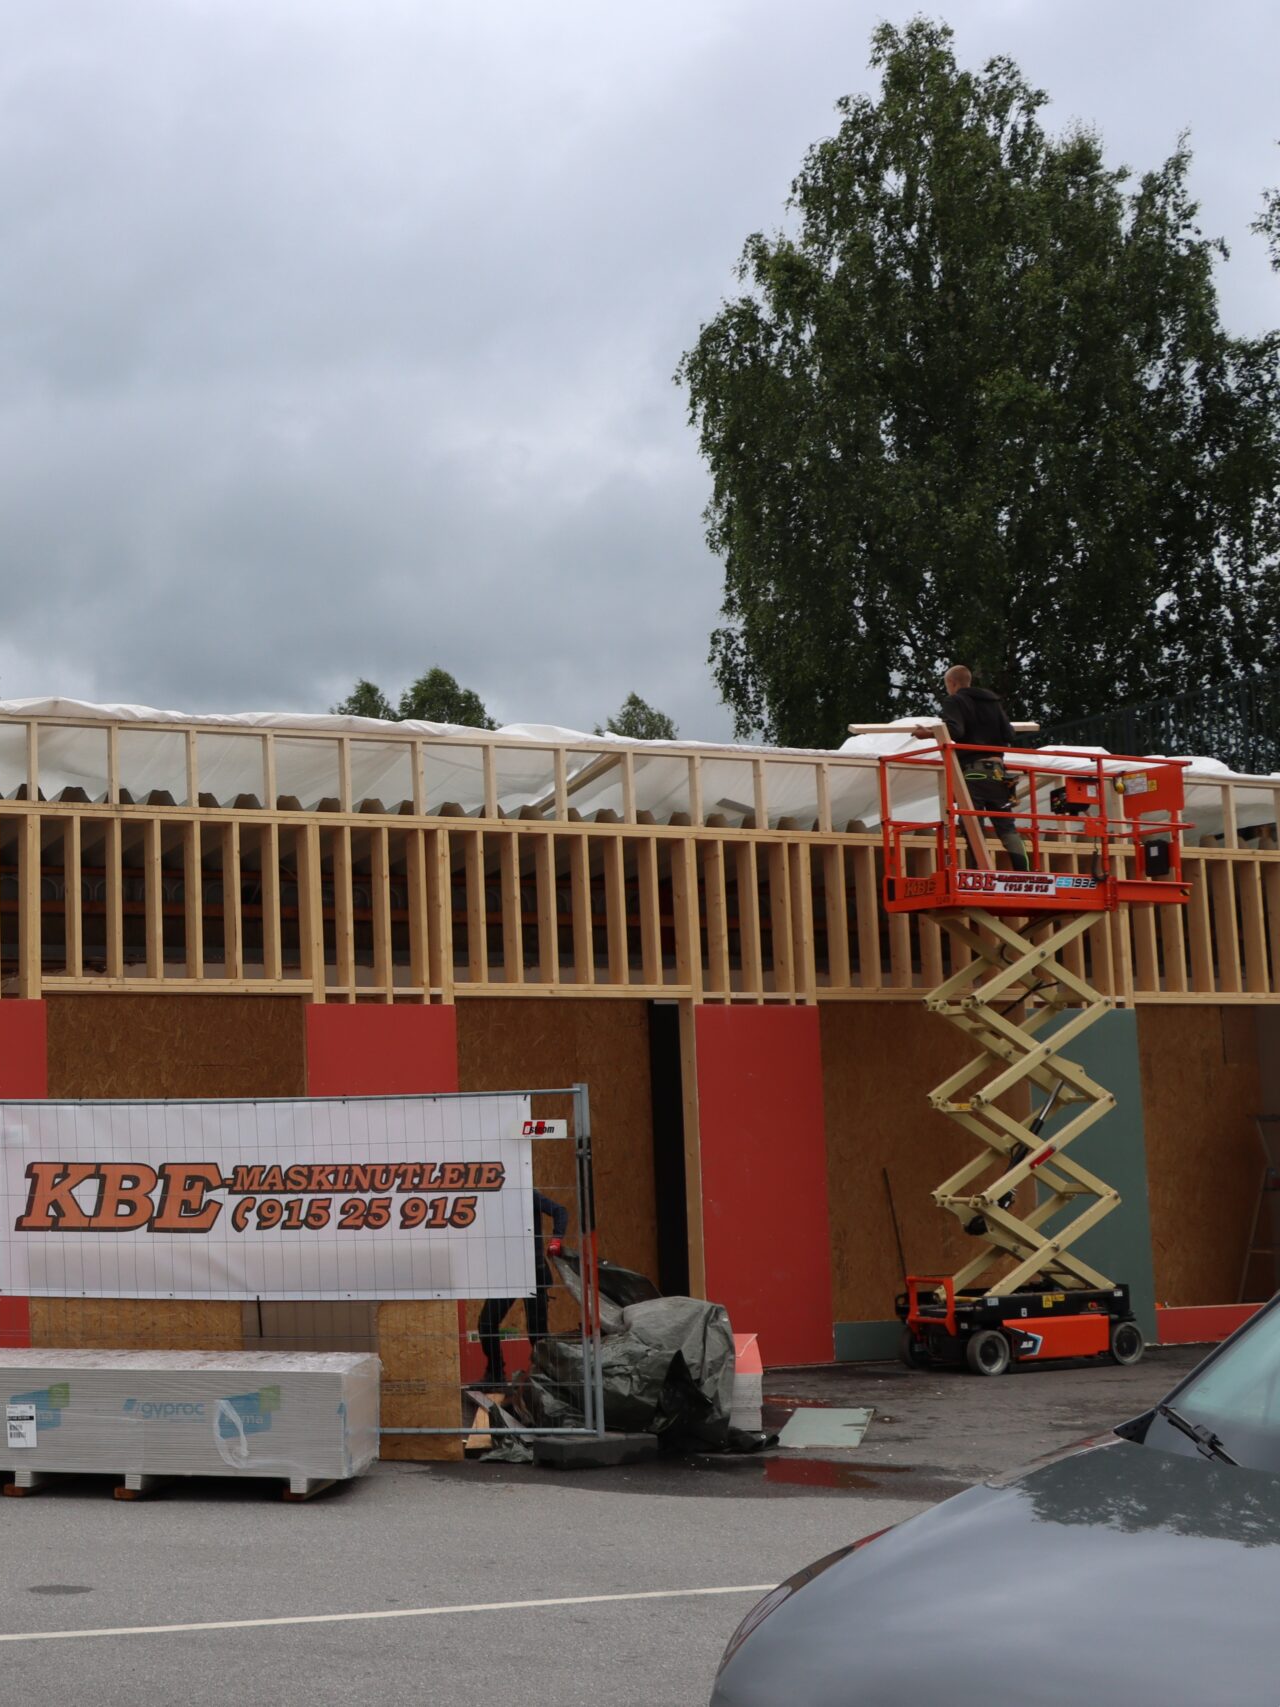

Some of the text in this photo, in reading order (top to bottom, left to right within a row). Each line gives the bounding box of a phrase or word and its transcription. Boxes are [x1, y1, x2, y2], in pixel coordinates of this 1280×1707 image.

[905, 878, 936, 897] KBE
[958, 873, 996, 891] KBE
[15, 1162, 223, 1232] KBE
[256, 1196, 477, 1229] 915 25 915
[141, 1401, 205, 1419] gyproc
